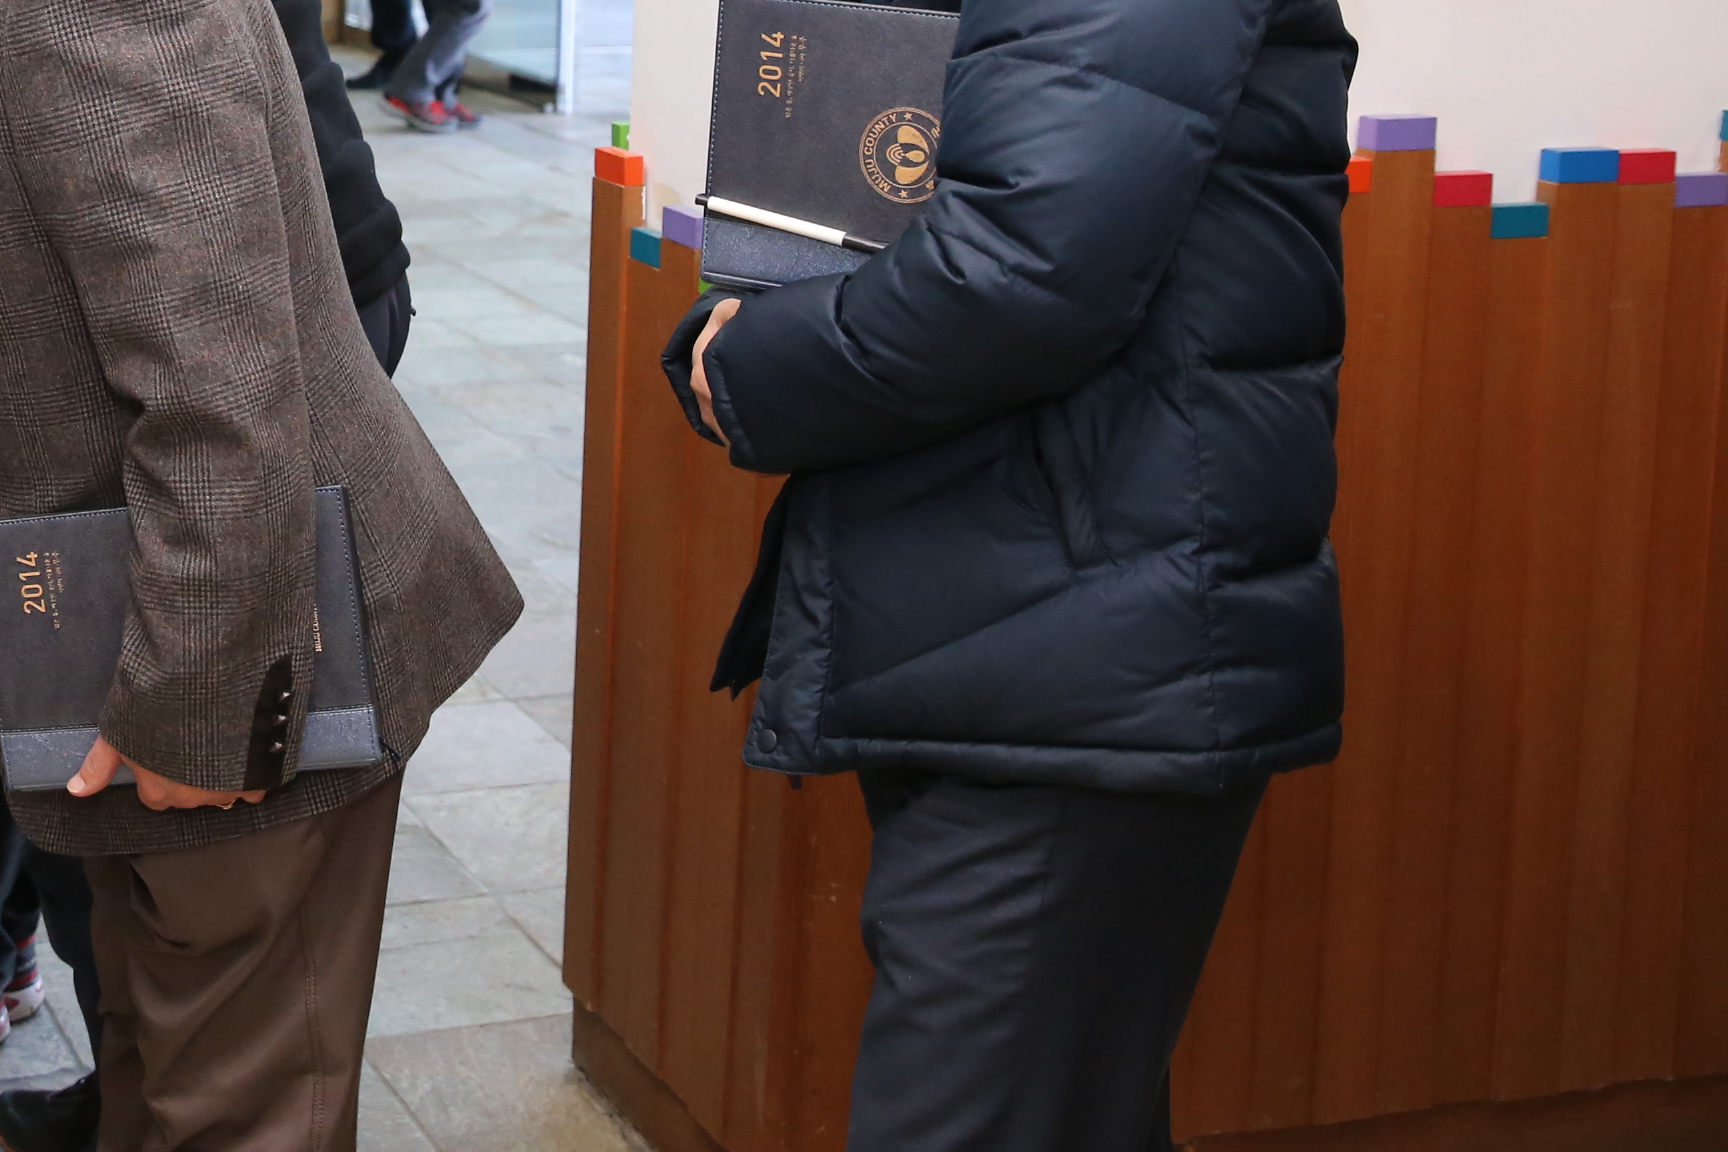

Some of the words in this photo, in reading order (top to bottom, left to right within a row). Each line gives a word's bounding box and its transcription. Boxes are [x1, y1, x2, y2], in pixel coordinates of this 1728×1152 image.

[757, 31, 785, 98] 2014
[864, 113, 897, 155] COUNTY
[865, 159, 891, 192] MUJU
[16, 551, 47, 614] 2014
